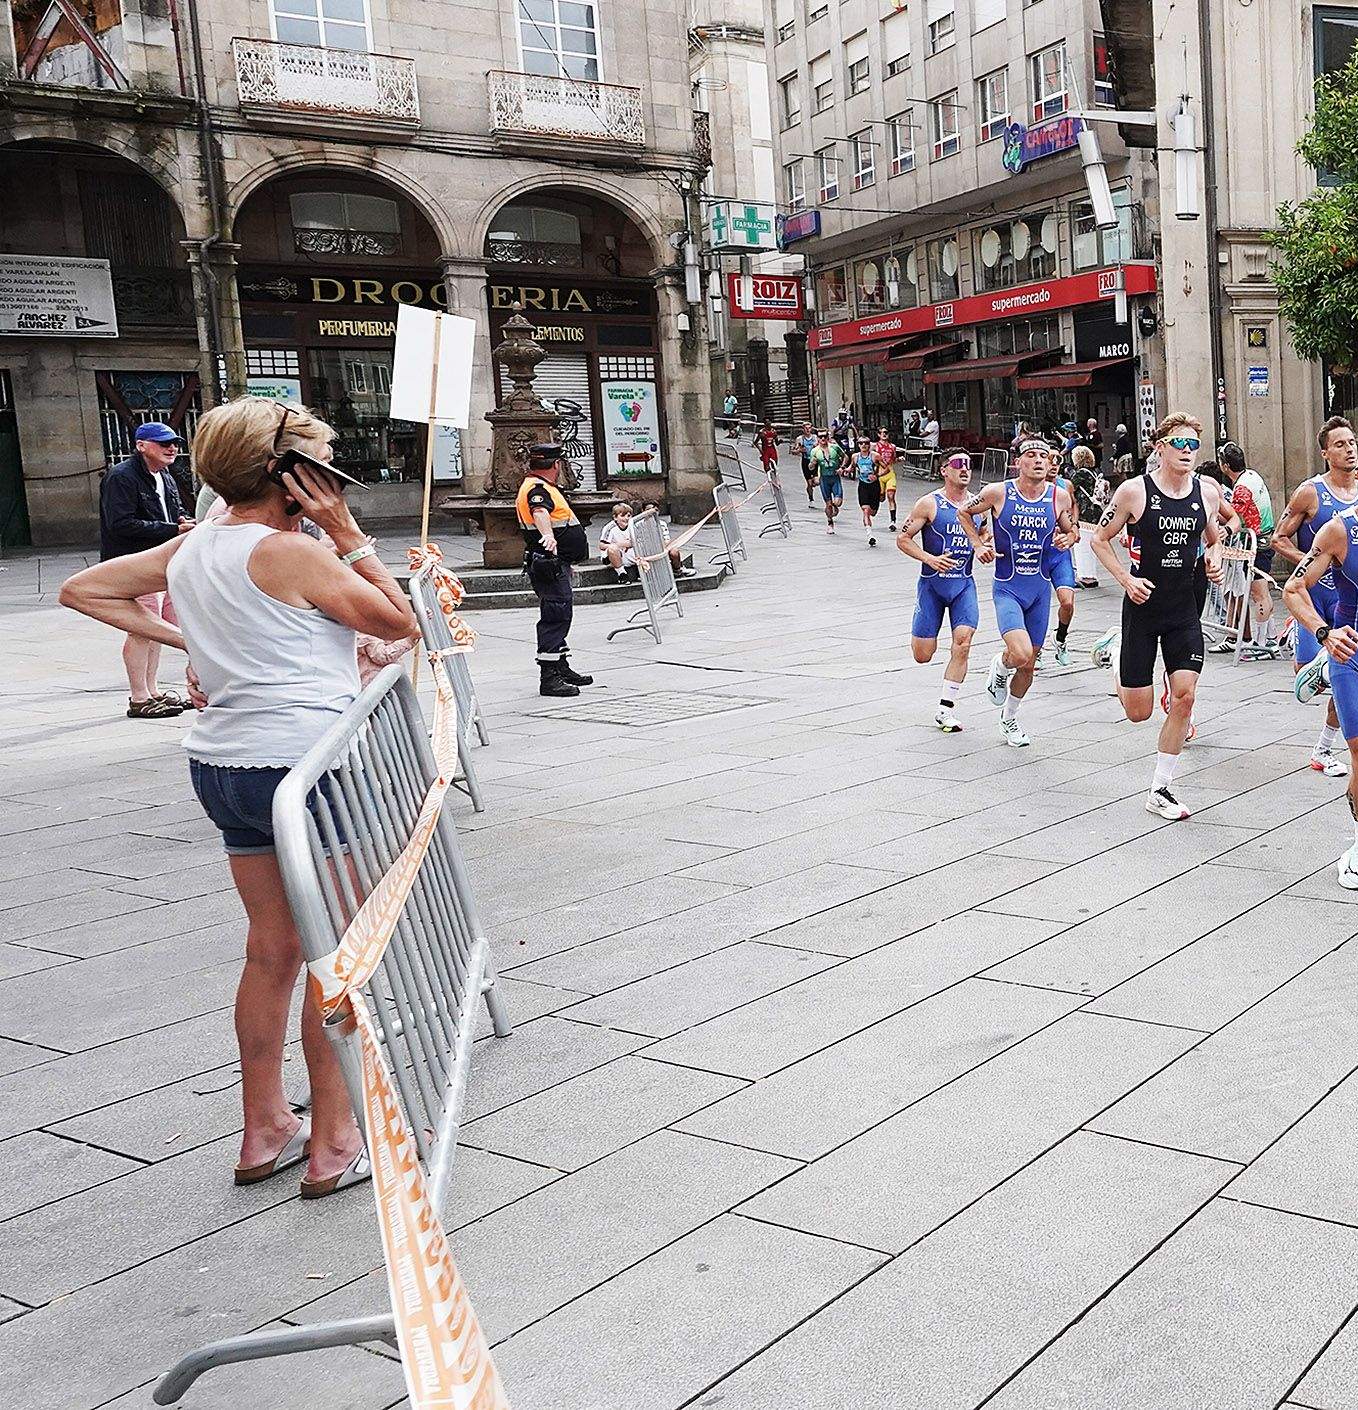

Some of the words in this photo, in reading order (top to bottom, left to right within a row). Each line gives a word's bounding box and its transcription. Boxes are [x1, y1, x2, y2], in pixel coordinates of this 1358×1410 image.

[735, 220, 768, 230] FARMACIA
[1099, 272, 1115, 291] FRO
[736, 281, 796, 299] ROIZ
[991, 288, 1051, 312] supermercado
[318, 319, 397, 336] PERFUMERIA
[859, 317, 902, 336] supermercado
[1099, 343, 1130, 358] MARCO
[1011, 515, 1048, 529] STARCK
[1158, 516, 1197, 531] DOWNEY
[951, 536, 968, 547] FRA
[1019, 530, 1038, 541] FRA
[1163, 532, 1188, 545] GBR
